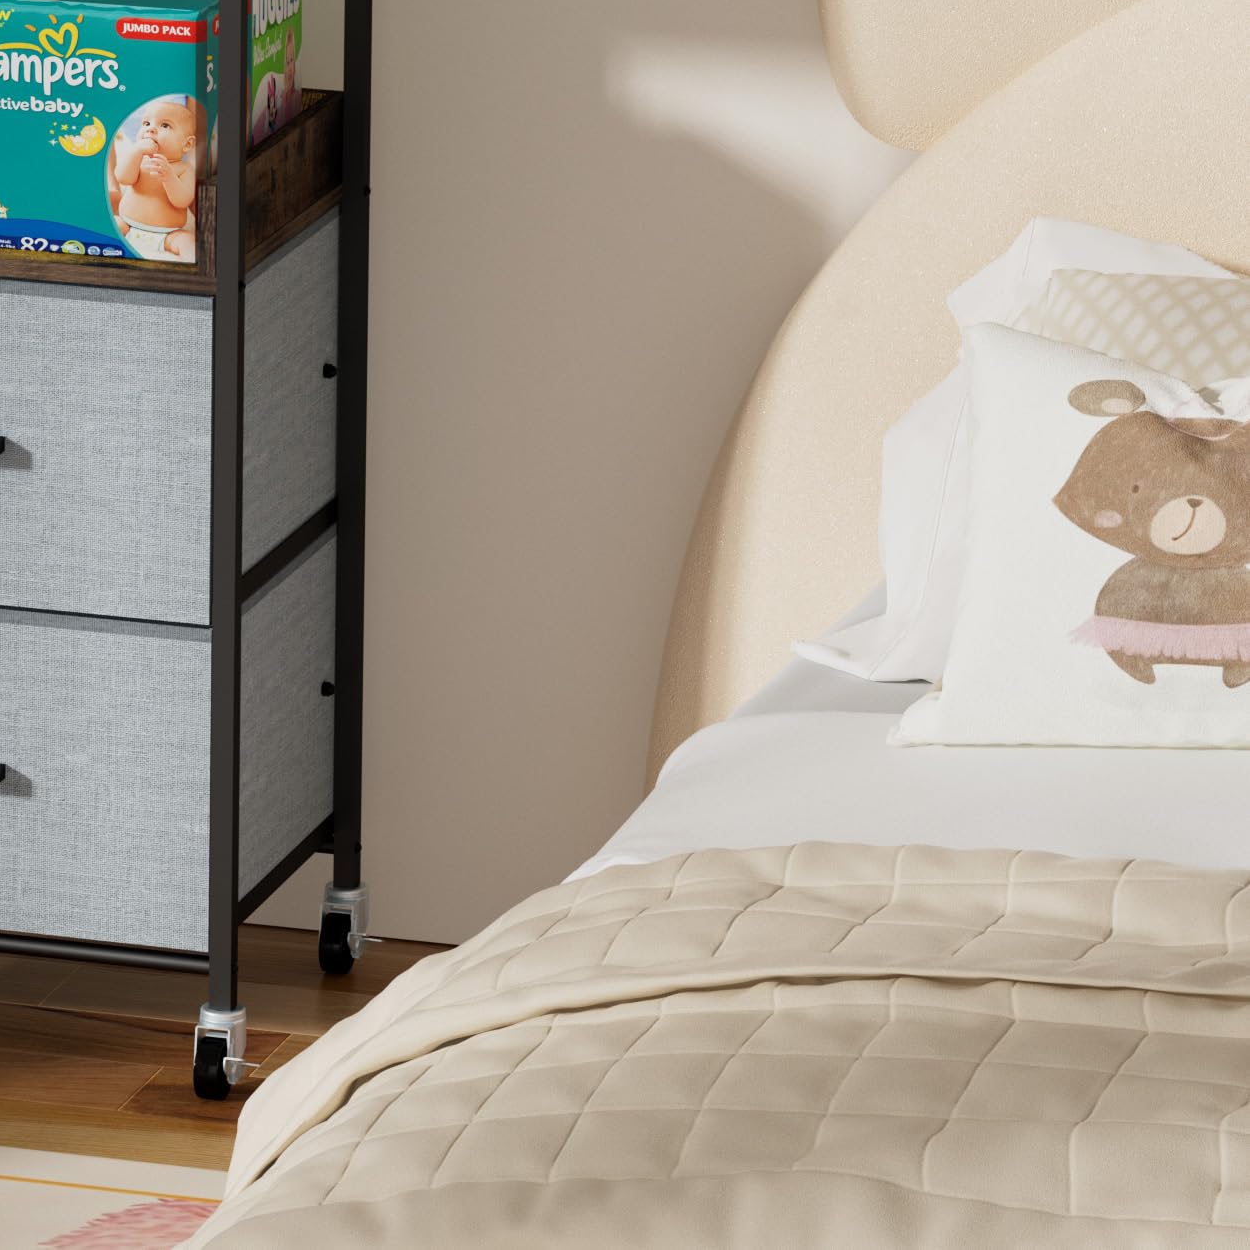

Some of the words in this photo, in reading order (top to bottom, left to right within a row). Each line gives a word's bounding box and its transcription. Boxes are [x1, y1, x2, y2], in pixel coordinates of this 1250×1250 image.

[122, 22, 159, 34] JUMBO
[162, 25, 191, 37] PACK
[20, 236, 49, 252] 82
